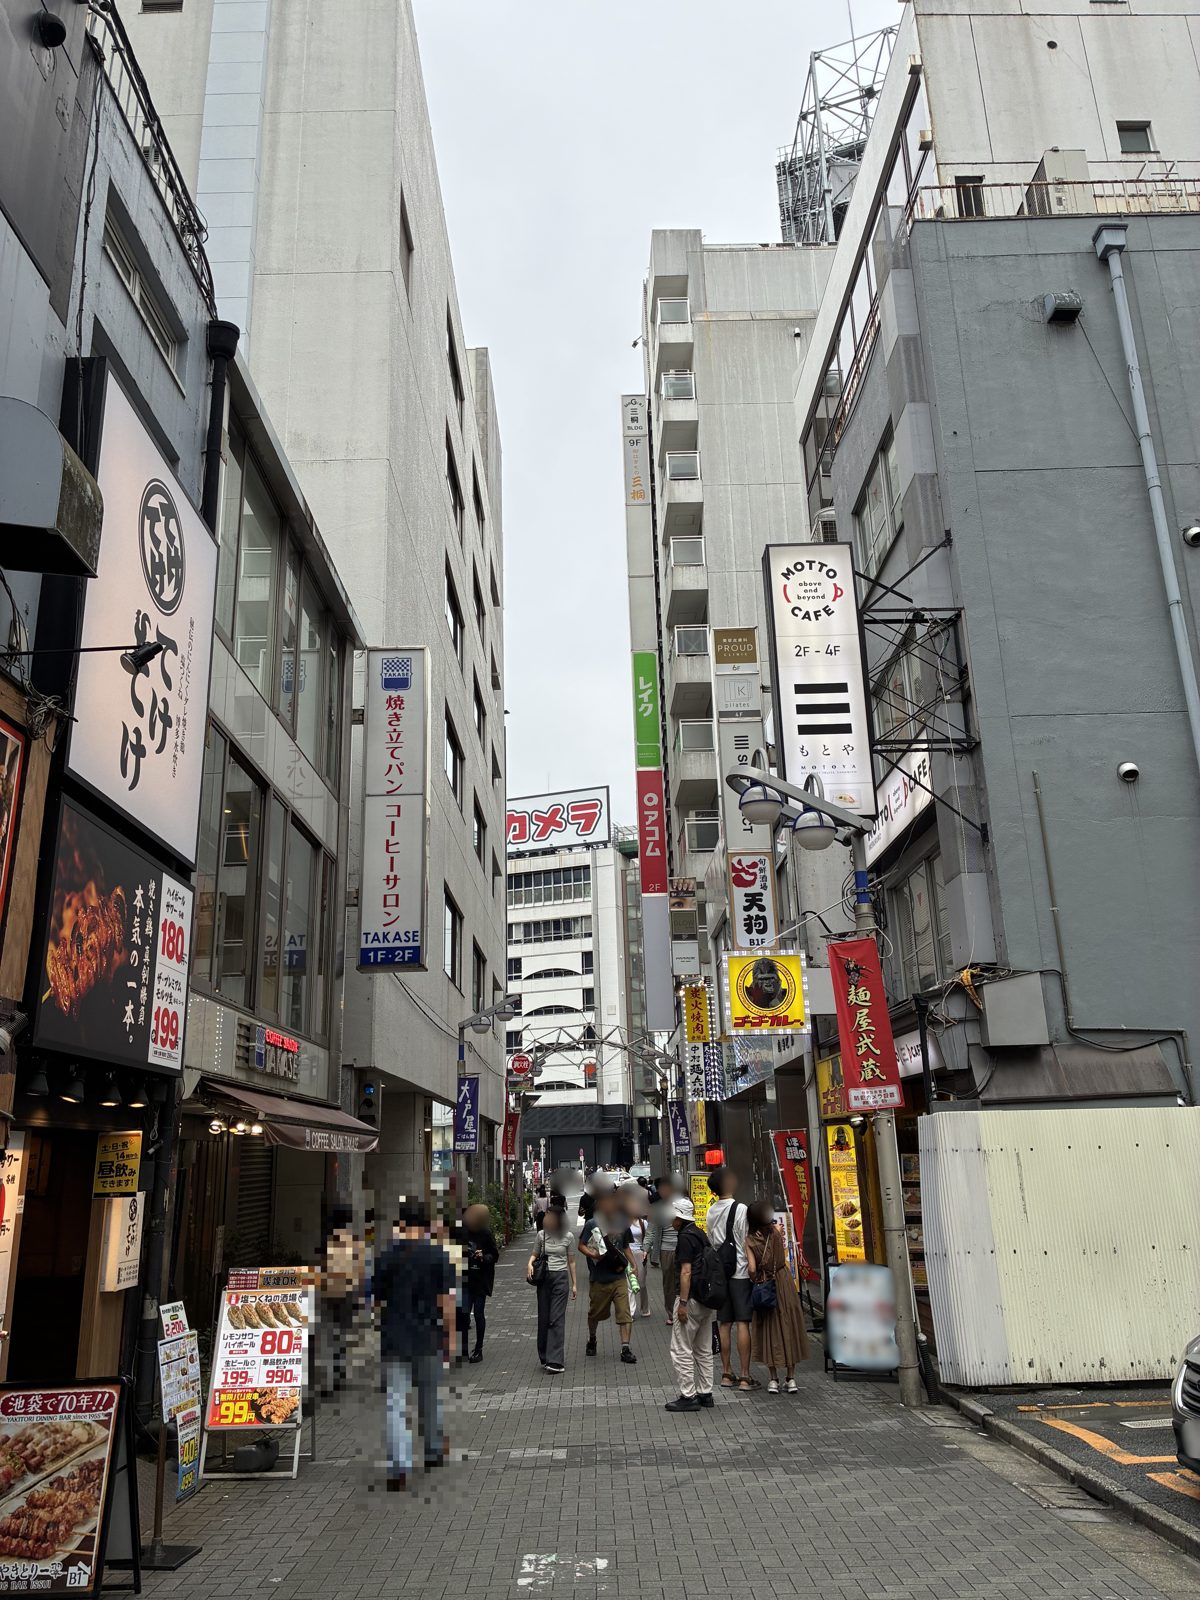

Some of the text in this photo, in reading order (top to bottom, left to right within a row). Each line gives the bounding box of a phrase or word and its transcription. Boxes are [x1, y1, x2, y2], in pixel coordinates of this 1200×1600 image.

[781, 560, 838, 581] MOTTO
[791, 604, 835, 621] CAFE
[717, 643, 753, 653] PROUD
[794, 645, 810, 657] 2F
[825, 644, 841, 657] 4F
[638, 676, 653, 717] レイク
[385, 695, 405, 794] 焼き立てパン
[800, 744, 854, 757] もとや
[507, 799, 603, 845] カメラ
[643, 811, 661, 857] アコム
[382, 804, 401, 928] コーヒーサロン
[648, 884, 661, 892] 2F
[743, 892, 769, 935] 天狗
[363, 930, 420, 944] TAKASE
[749, 938, 767, 946] B1F
[690, 987, 704, 1034] 炭火焼肉
[734, 1014, 802, 1028] ゴーゴーカレー
[847, 984, 887, 1082] 麺屋武蔵
[458, 1080, 476, 1133] 大戸屋
[671, 1103, 689, 1140] 大戸屋
[311, 1131, 329, 1150] COFFEE
[330, 1133, 345, 1151] SALON
[97, 1162, 137, 1179] 昼飲み
[240, 1293, 297, 1304] 塩つくねの酒場
[222, 1333, 260, 1341] レモンサワー
[224, 1341, 256, 1349] ハイボール
[260, 1330, 302, 1355] 80円
[221, 1371, 254, 1386] 199円
[266, 1369, 299, 1384] 990円
[7, 1392, 110, 1413] 池袋で70年!!
[220, 1401, 256, 1424] 99円
[68, 1572, 83, 1586] B1
